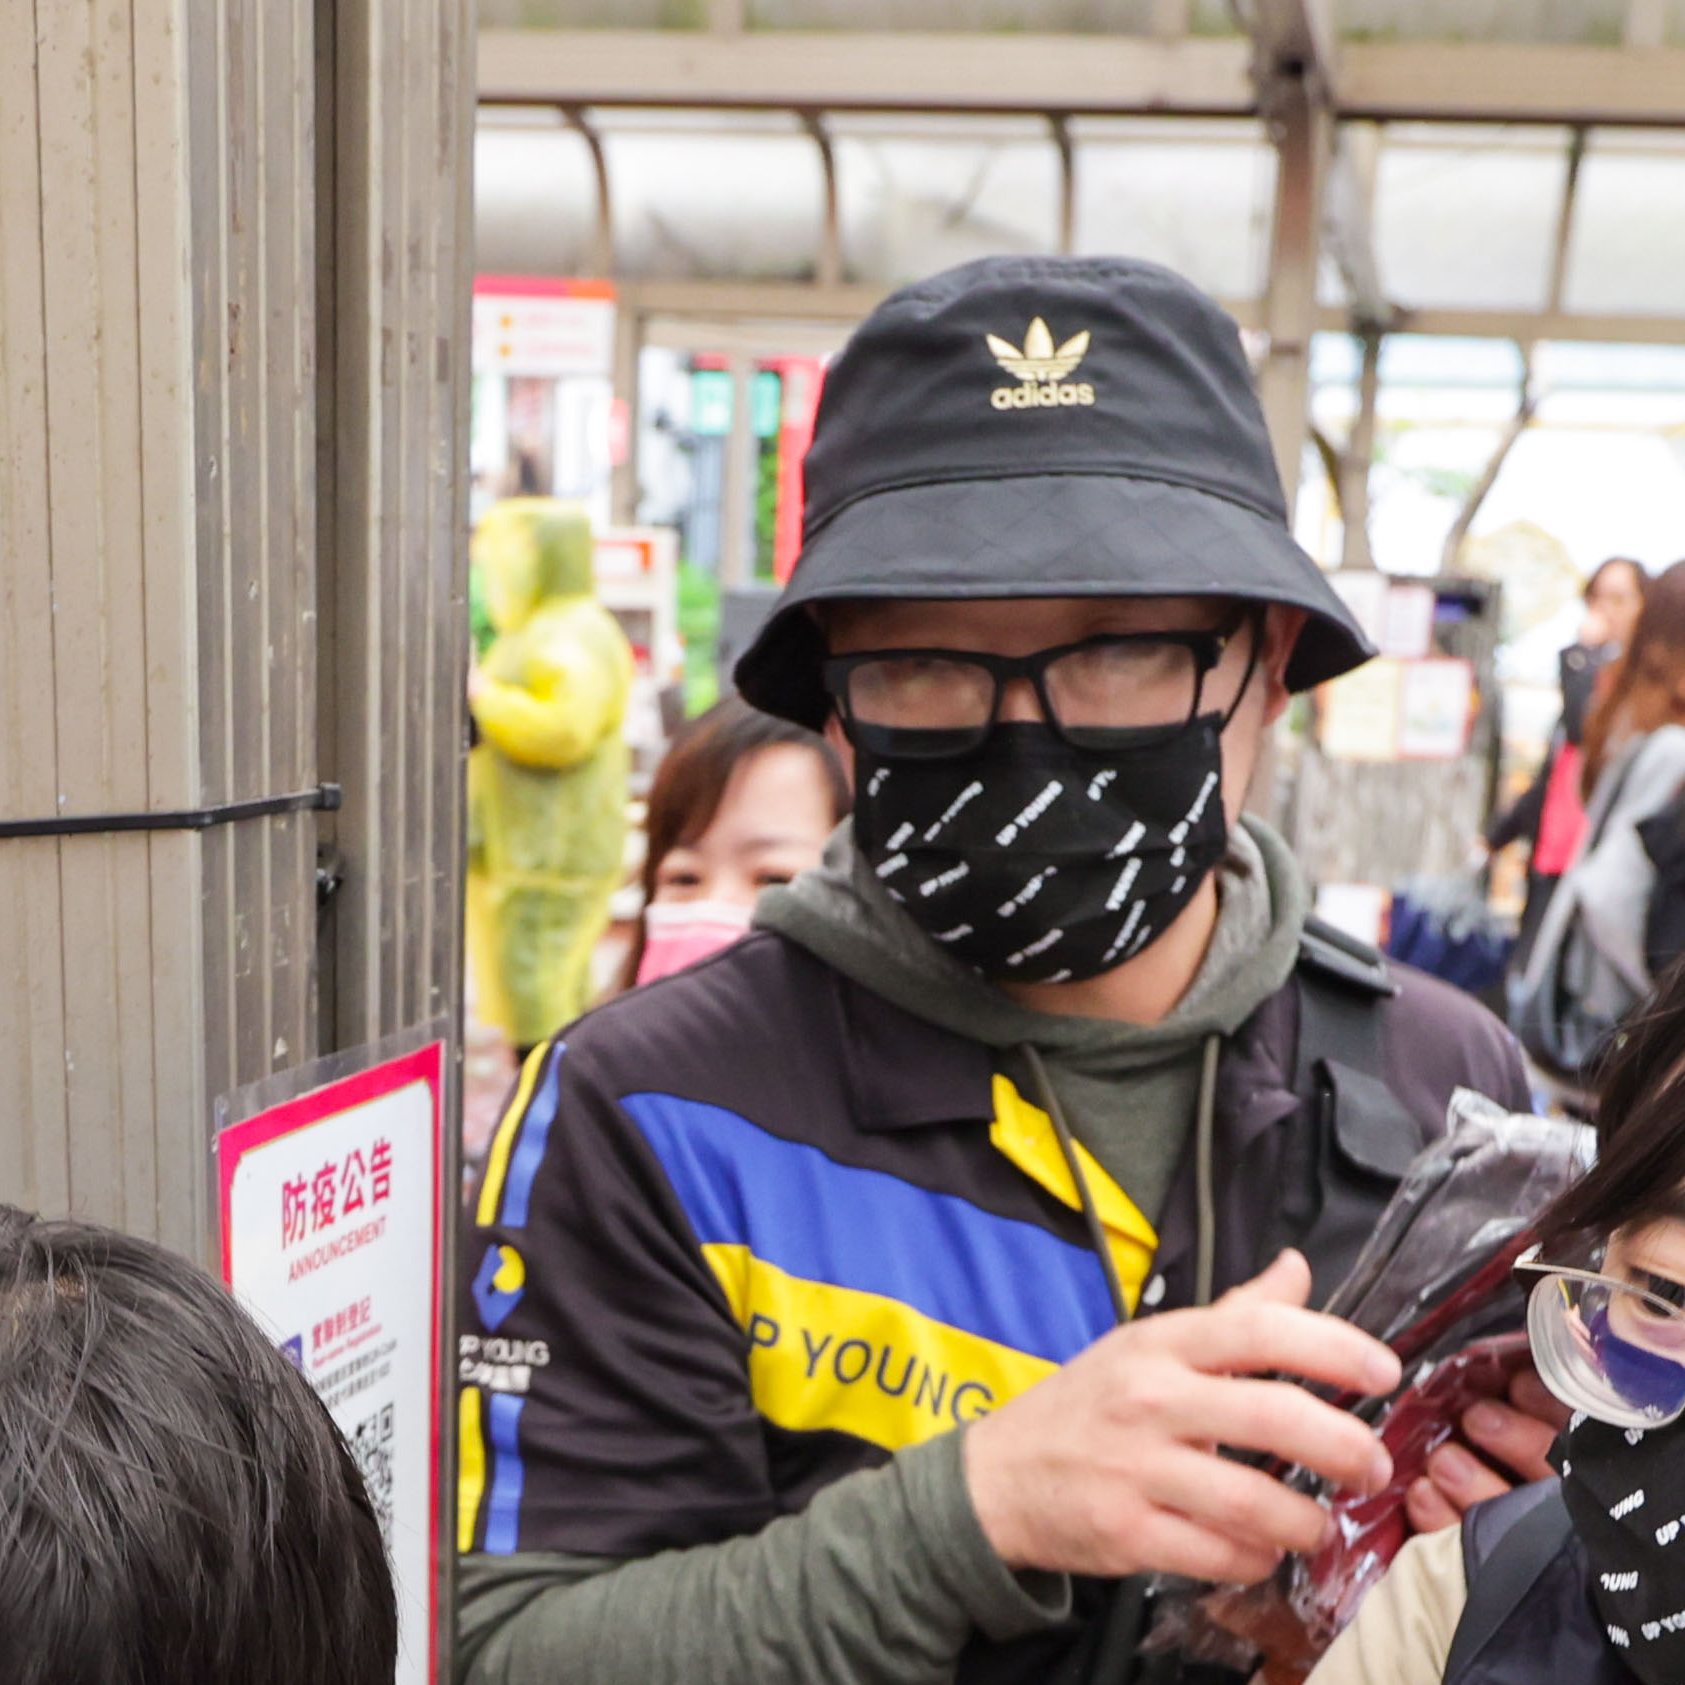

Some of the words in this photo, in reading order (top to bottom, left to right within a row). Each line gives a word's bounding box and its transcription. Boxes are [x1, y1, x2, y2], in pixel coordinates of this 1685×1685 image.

[991, 380, 1095, 411] adidas
[1014, 779, 1064, 829] YOUNG
[282, 1137, 392, 1250] 防疫公告
[289, 1214, 387, 1284] ANNOUNCEMENT
[801, 1327, 995, 1423] YOUNG
[1655, 1520, 1681, 1546] UP
[1641, 1620, 1662, 1641] UP
